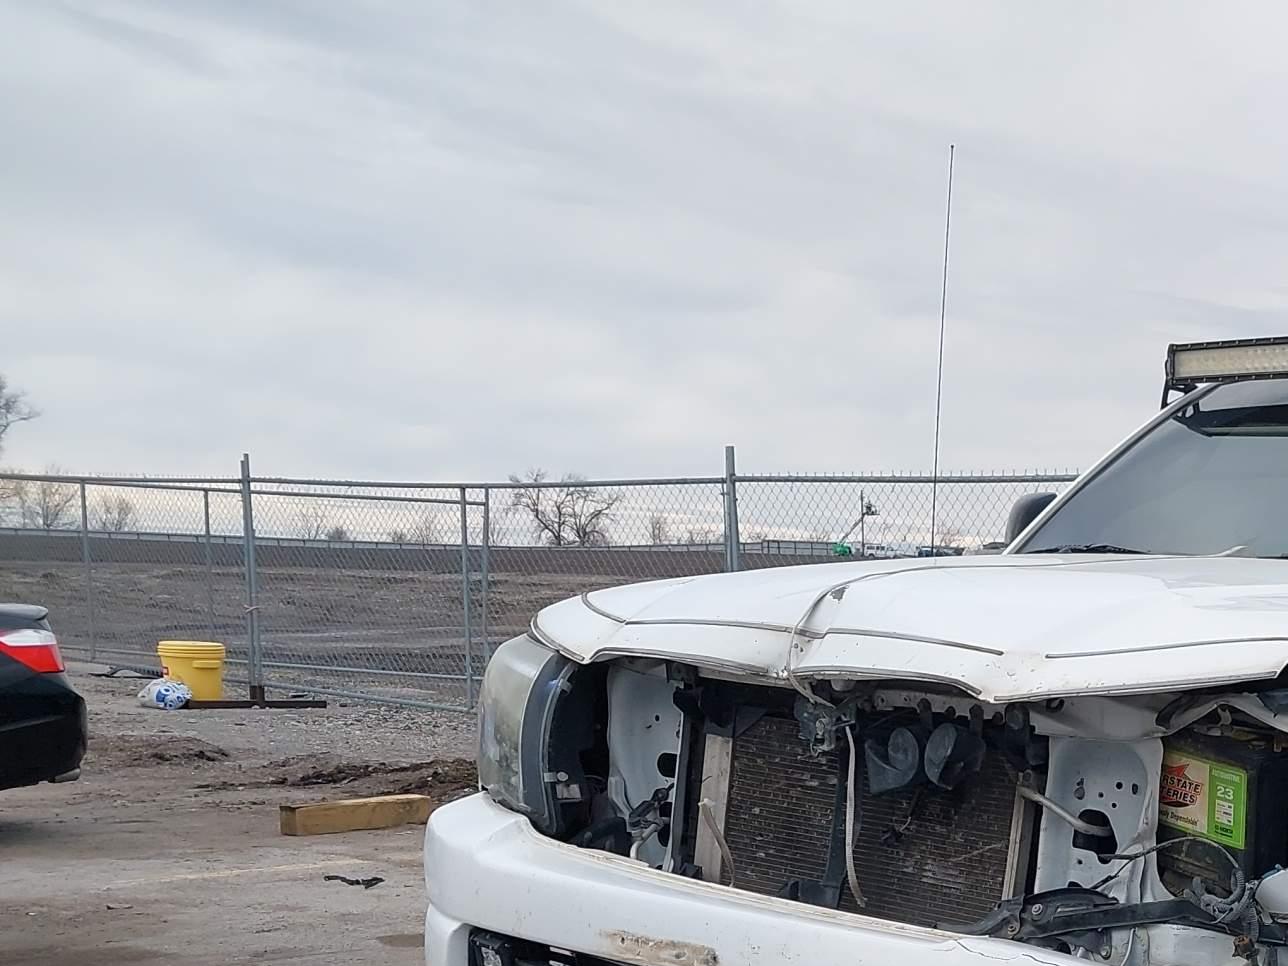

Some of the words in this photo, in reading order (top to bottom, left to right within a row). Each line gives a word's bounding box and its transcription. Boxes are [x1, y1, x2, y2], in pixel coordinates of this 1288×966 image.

[1163, 774, 1200, 793] RSTATE
[1216, 785, 1234, 800] 23
[1160, 784, 1196, 804] TERIES
